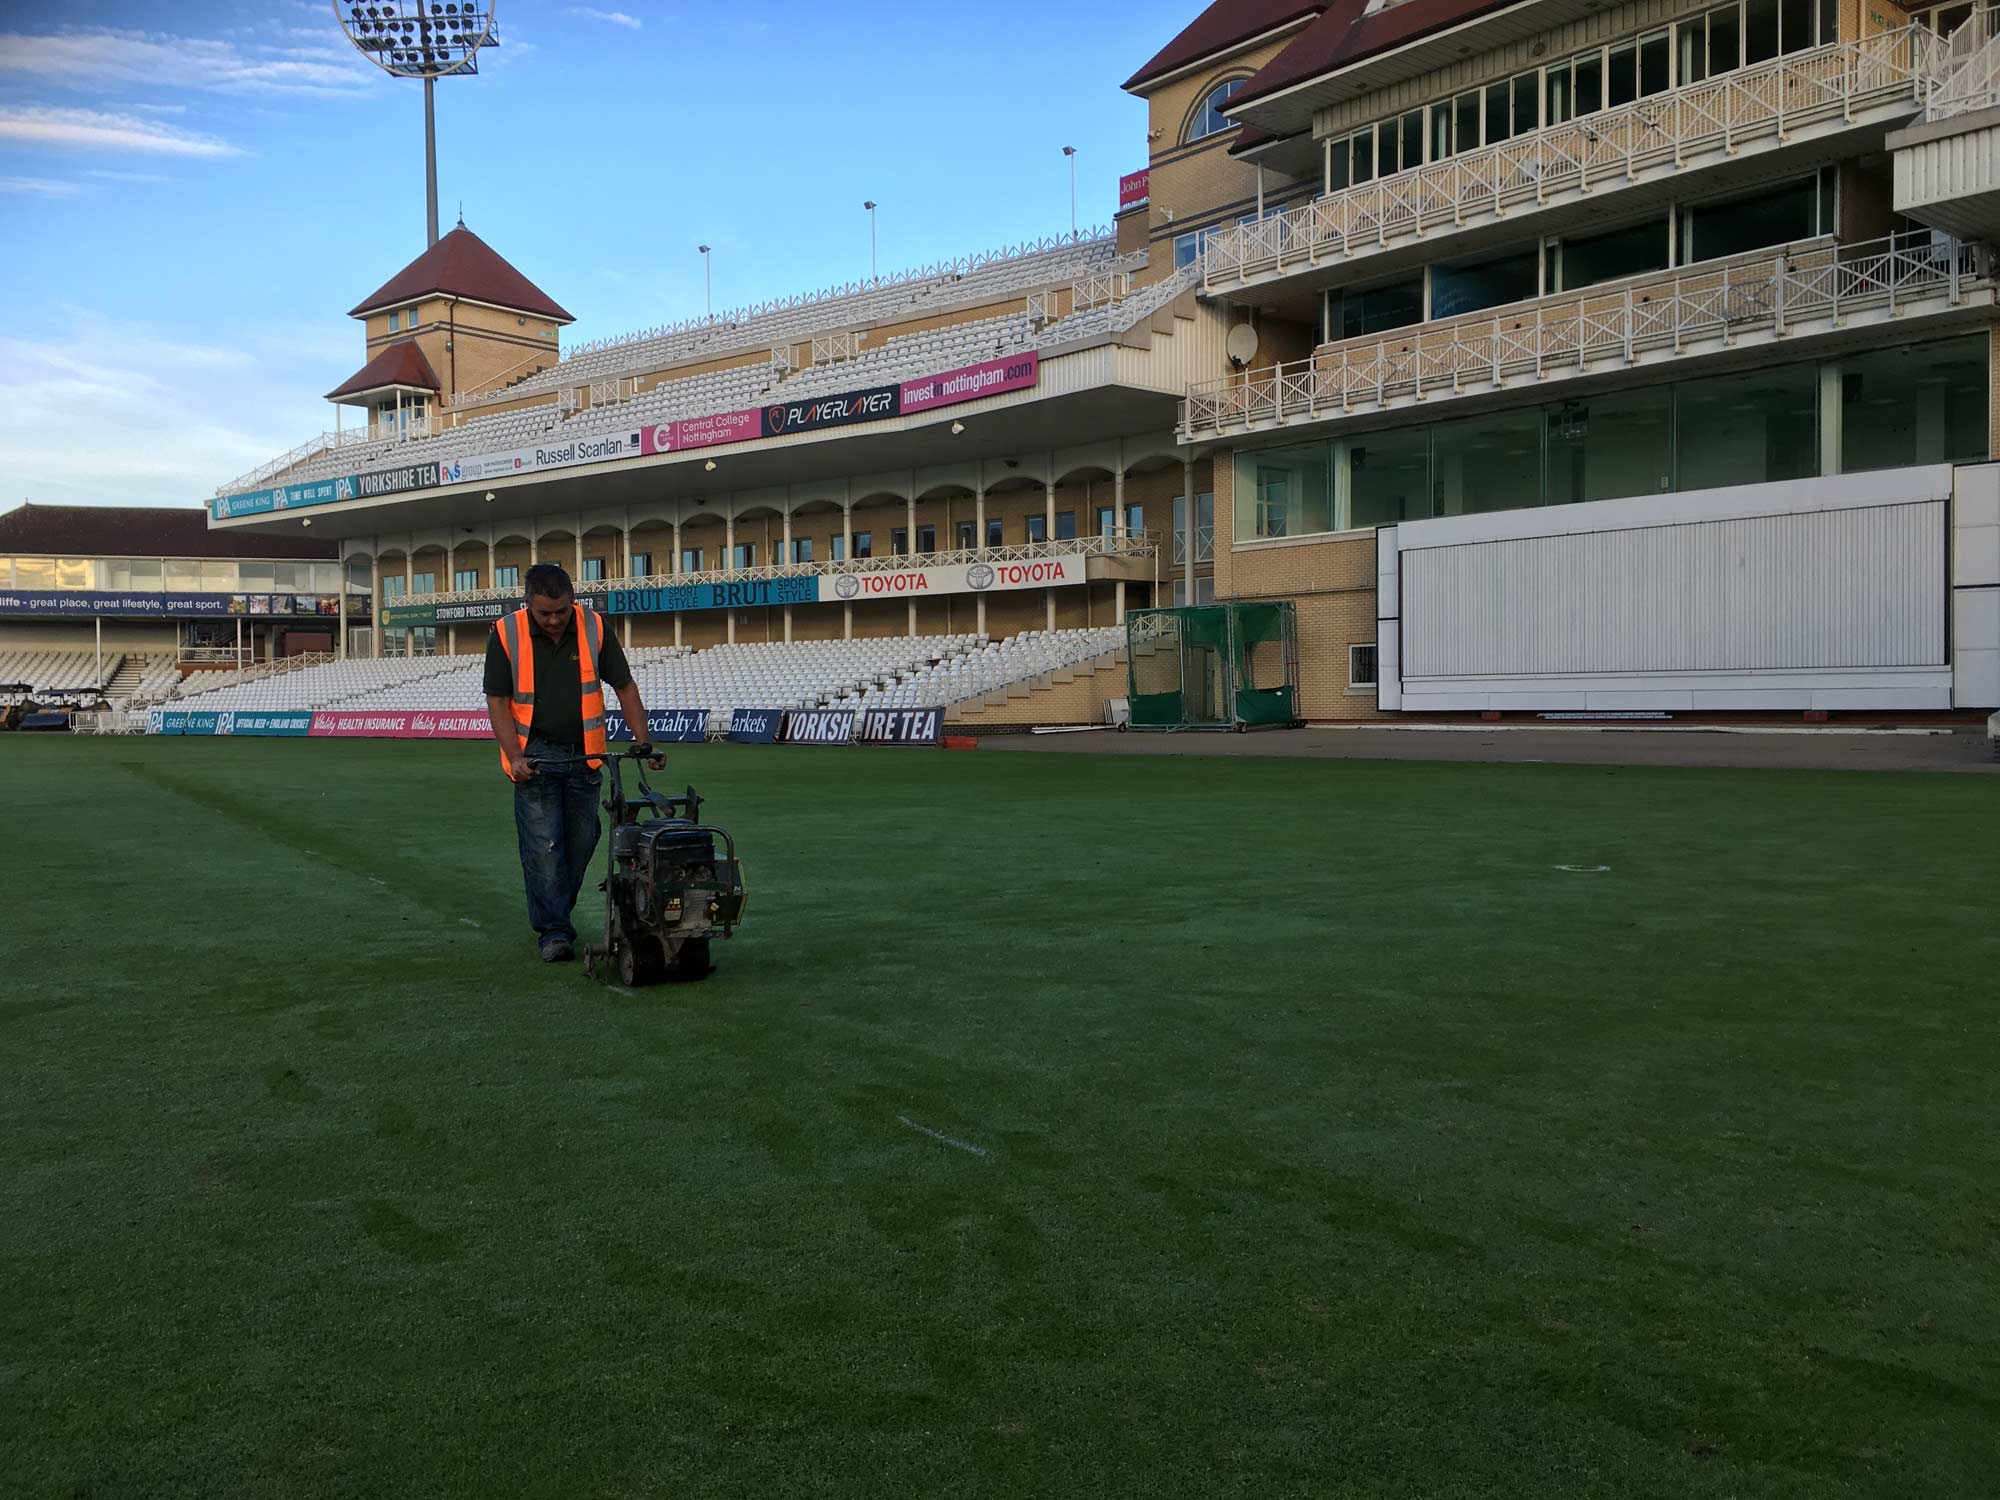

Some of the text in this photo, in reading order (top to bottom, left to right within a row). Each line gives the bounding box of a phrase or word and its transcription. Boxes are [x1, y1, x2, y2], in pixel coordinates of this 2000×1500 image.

[1121, 180, 1141, 194] John
[787, 393, 892, 426] PLAYERLAYER
[682, 413, 750, 432] Central College
[683, 428, 732, 444] Nottingham
[536, 447, 576, 466] Russell
[578, 439, 622, 458] Scanlan
[360, 465, 437, 494] YORKSHIRE TEA
[462, 464, 482, 480] group
[273, 488, 288, 509] IPA
[336, 476, 352, 500] IPA
[216, 496, 270, 518] IPA GREENE KING
[778, 577, 811, 590] SPORT
[862, 573, 928, 593] TOYOTA
[997, 562, 1065, 584] TOYOTA
[614, 590, 663, 612] BRUT
[668, 586, 698, 598] SPORT
[669, 597, 698, 609] STYLE
[712, 582, 772, 607] BRUT
[778, 589, 811, 602] STYLE
[30, 599, 56, 609] great
[60, 598, 90, 609] place,
[93, 600, 120, 610] great
[122, 599, 162, 610] lifestyle,
[167, 600, 194, 610] great
[196, 600, 223, 611] sport.
[466, 606, 484, 618] PRESS
[484, 604, 502, 616] CIDER
[146, 712, 215, 734] IPA GREENE KING
[215, 712, 234, 735] IPA
[314, 713, 406, 735] Vitality HEALTH INSURANCE
[412, 713, 436, 736] Vitality
[438, 718, 468, 730] HEALTH
[785, 712, 853, 740] YORKSH
[863, 712, 936, 740] IRE TEA
